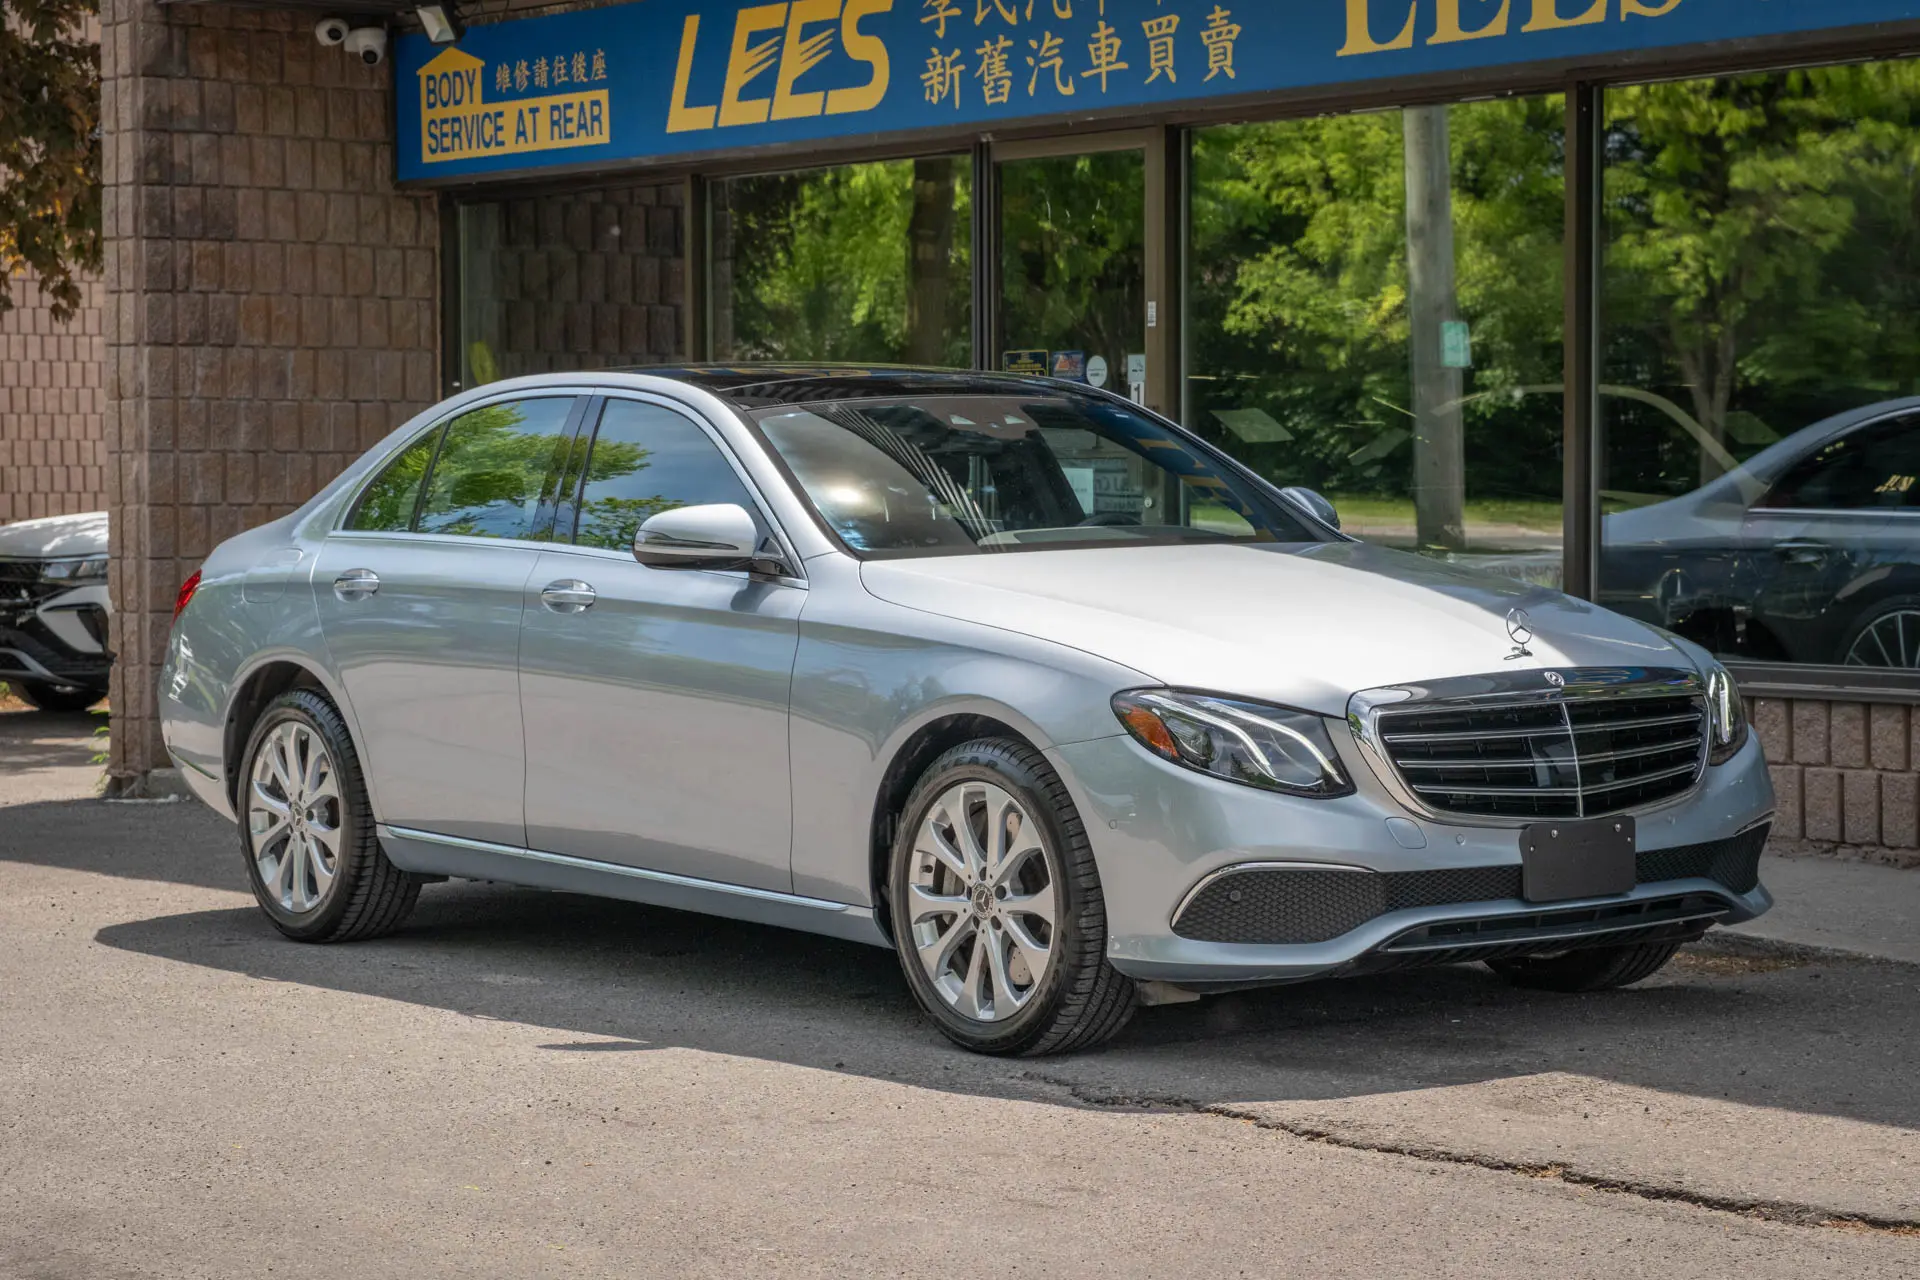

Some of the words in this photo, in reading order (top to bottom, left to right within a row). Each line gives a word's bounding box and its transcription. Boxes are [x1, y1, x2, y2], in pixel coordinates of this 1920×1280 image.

[495, 48, 608, 94] 維修請往後座
[666, 0, 893, 134] LEES
[919, 5, 1242, 111] 新舊汽車買賣
[426, 68, 477, 110] BODY
[427, 110, 506, 155] SERVICE
[515, 106, 540, 145] AT
[550, 99, 603, 141] REAR
